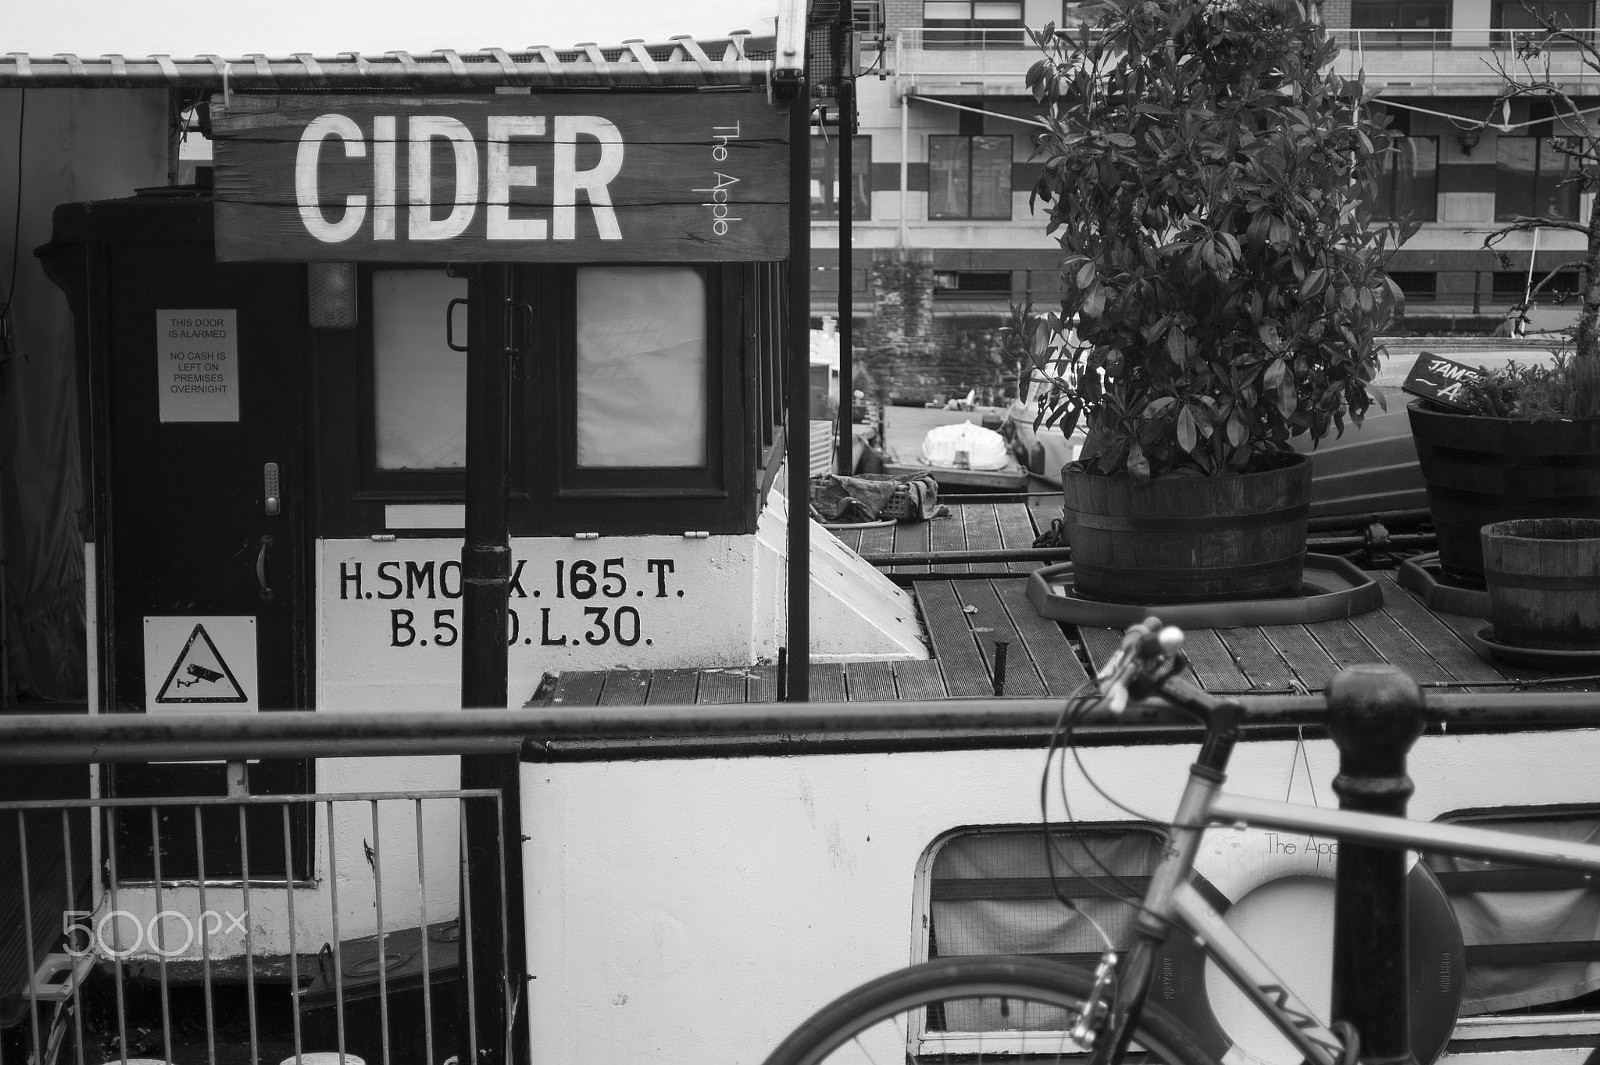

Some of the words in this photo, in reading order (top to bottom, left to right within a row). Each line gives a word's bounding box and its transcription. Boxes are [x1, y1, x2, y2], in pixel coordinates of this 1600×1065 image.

[713, 119, 740, 162] The
[295, 113, 624, 243] CIDER
[691, 171, 742, 236] Apple
[170, 318, 193, 327] THIS
[195, 318, 224, 327] DOOR
[168, 329, 178, 338] IS
[179, 329, 227, 338] ALARMED
[170, 351, 185, 360] NO
[187, 351, 214, 360] CASH
[216, 351, 226, 360] IS
[178, 363, 202, 371] LEFT
[204, 363, 219, 371] ON
[1428, 359, 1479, 380] JAME
[173, 374, 224, 382] PREMISES
[170, 385, 228, 393] OVERNIGHT
[1264, 832, 1297, 855] The
